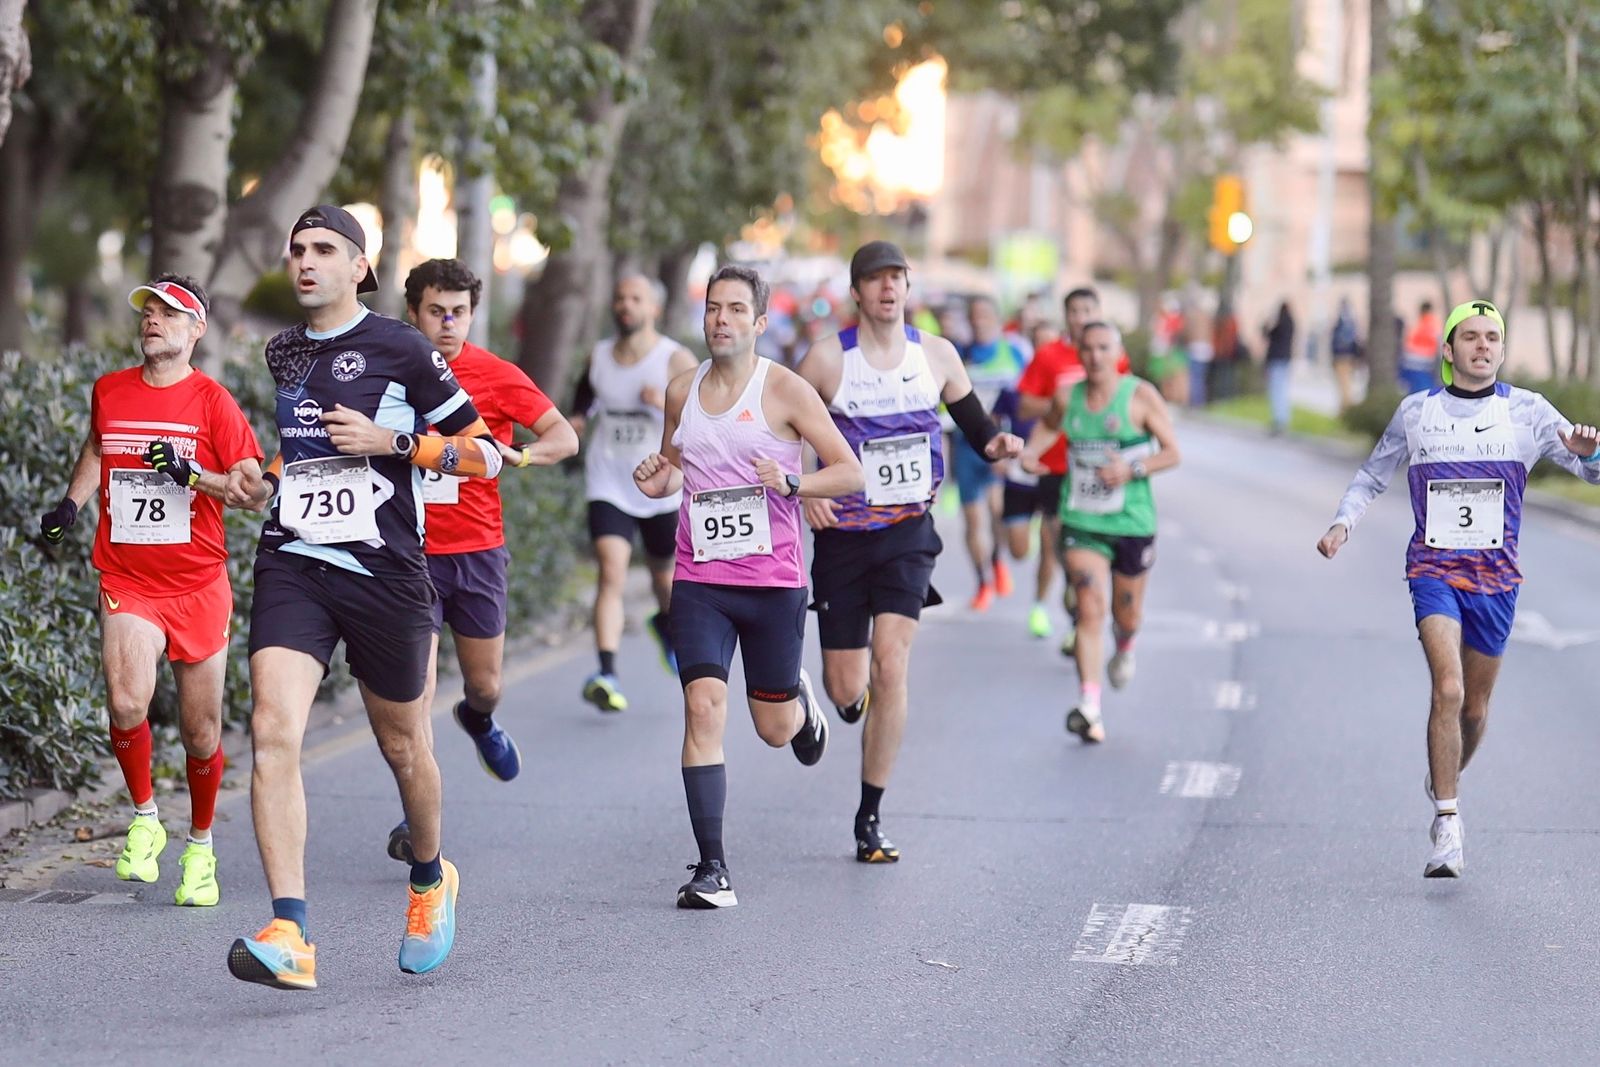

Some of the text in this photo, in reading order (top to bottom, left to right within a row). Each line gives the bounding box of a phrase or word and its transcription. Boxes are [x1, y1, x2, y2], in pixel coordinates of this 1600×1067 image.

[293, 407, 322, 417] HPM
[878, 461, 921, 486] 915
[132, 498, 166, 522] 78
[299, 488, 355, 520] 730
[704, 513, 754, 540] 955
[1458, 506, 1473, 528] 3
